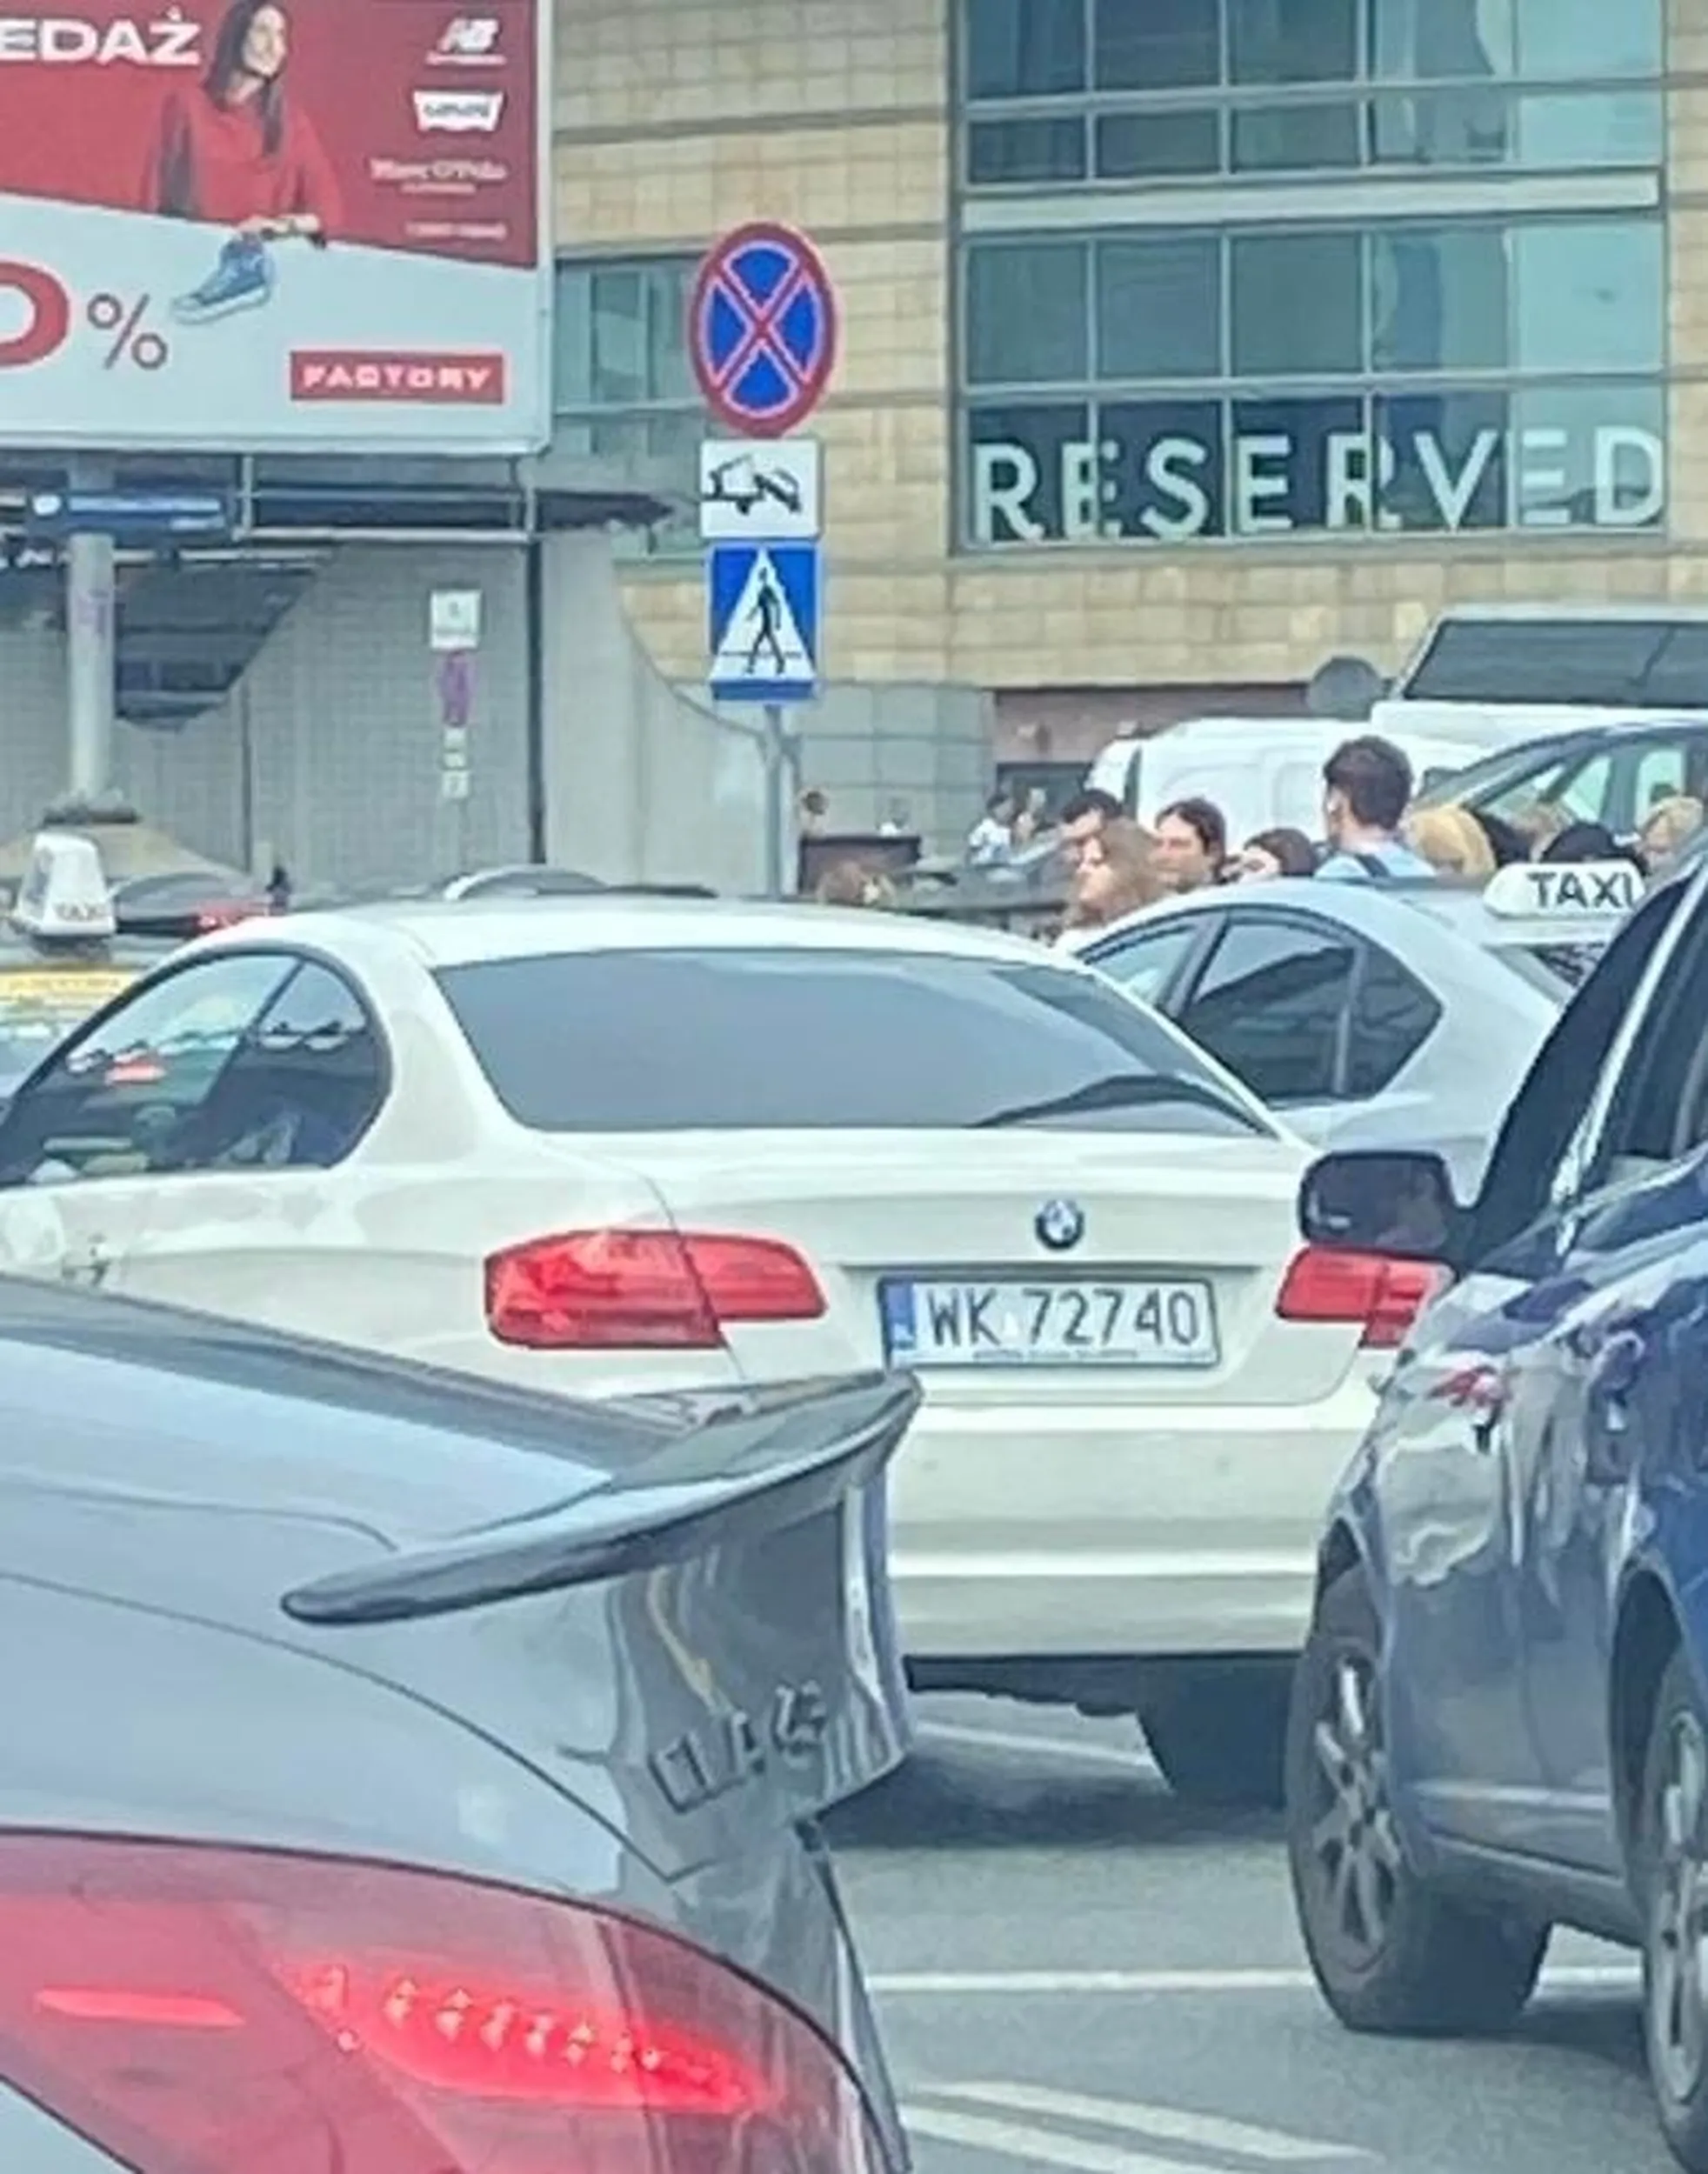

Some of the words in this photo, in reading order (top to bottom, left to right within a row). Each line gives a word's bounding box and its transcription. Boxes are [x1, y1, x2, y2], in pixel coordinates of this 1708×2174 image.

[0, 5, 202, 66] EDAŻ
[303, 363, 491, 390] FACTORY
[969, 425, 1665, 543] RESERVED
[1526, 871, 1634, 909] TAXI
[928, 1289, 1000, 1346] WK
[1023, 1288, 1198, 1345] 72740
